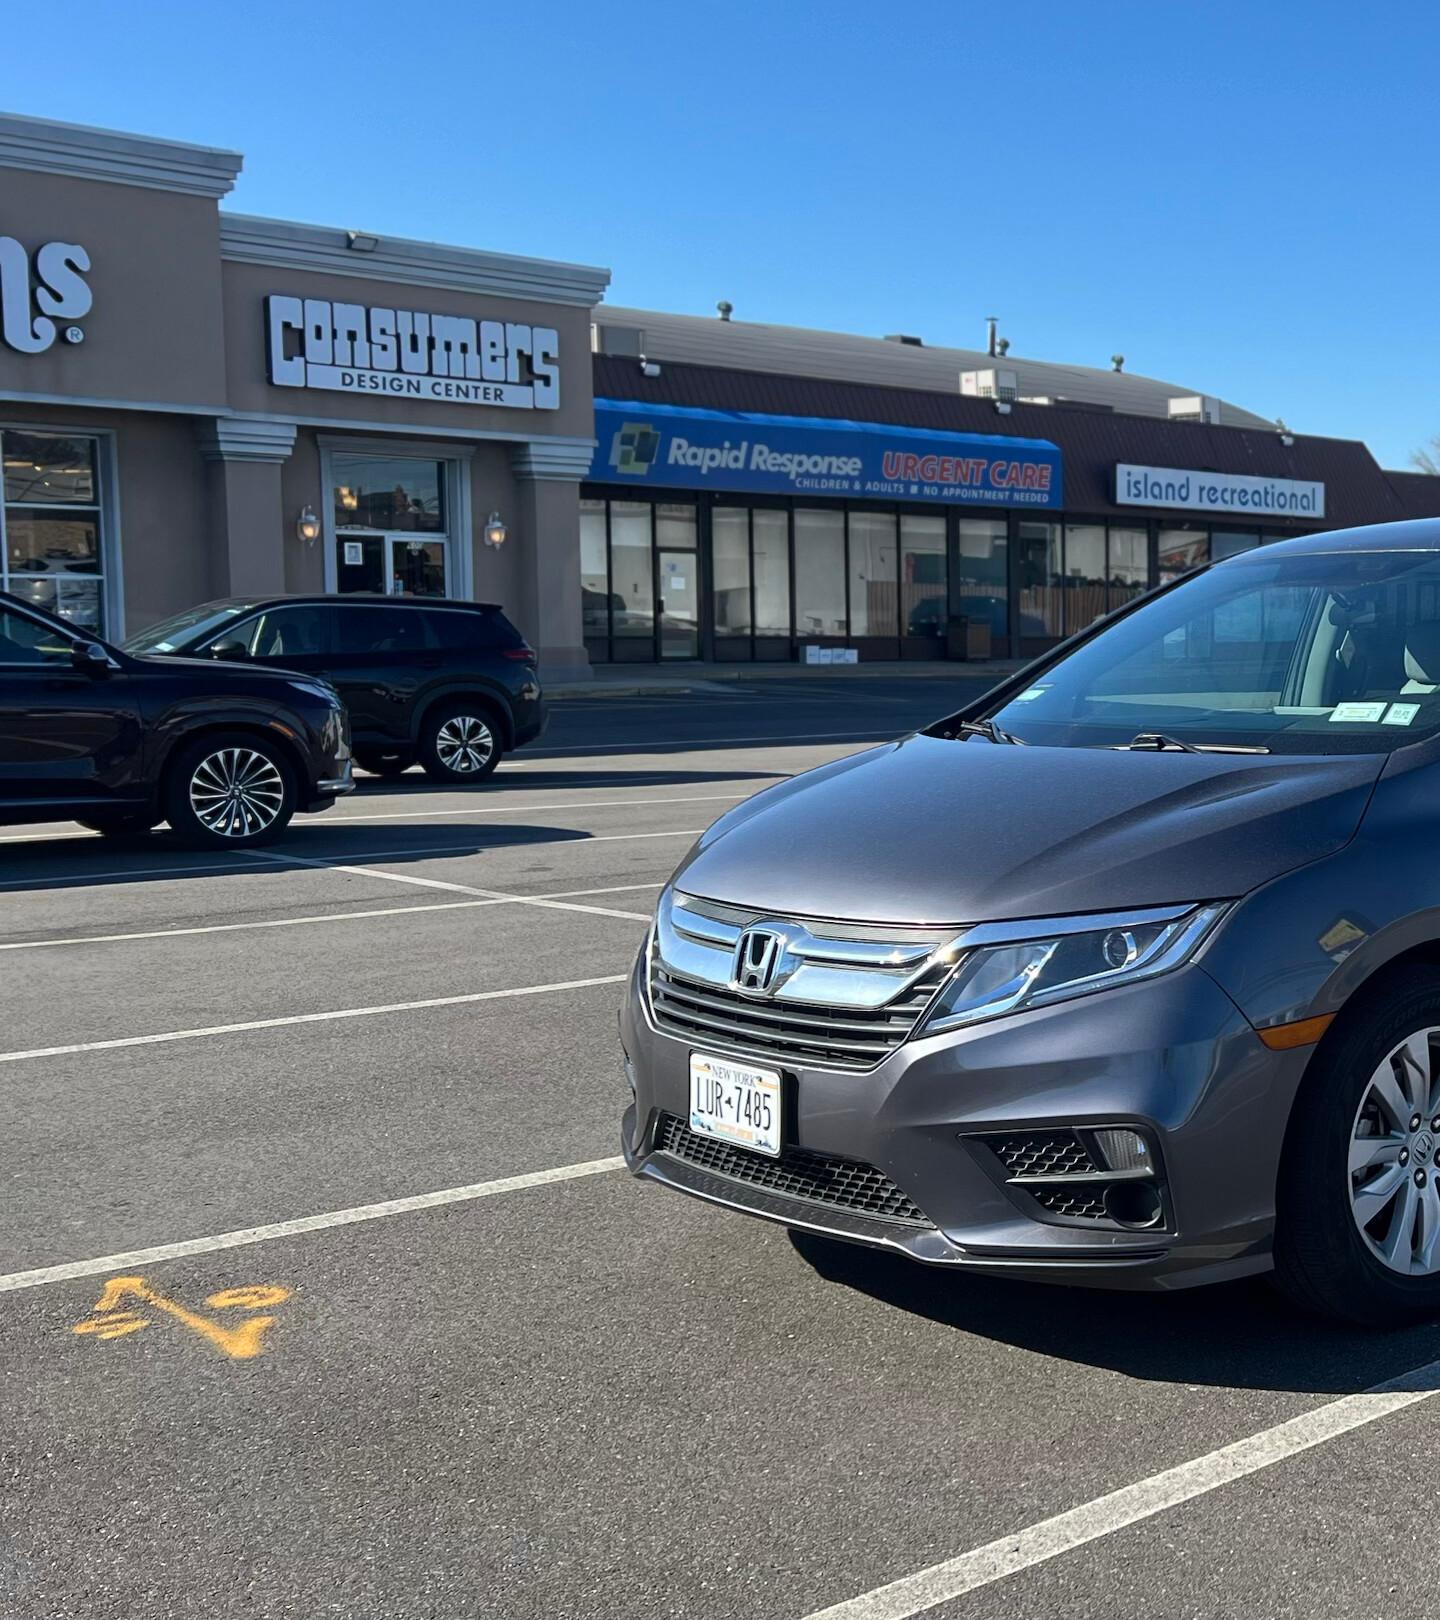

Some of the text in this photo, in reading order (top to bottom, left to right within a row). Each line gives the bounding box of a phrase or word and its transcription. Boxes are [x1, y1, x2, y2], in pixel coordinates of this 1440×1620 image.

[341, 372, 504, 402] DESIGN CENTER
[667, 437, 1052, 491] Rapid Response URGENT CARE
[795, 478, 1049, 503] CHILDREN & ADULTS NO APPOINTMENT NEEDED
[1126, 471, 1316, 512] island recreational
[712, 1065, 757, 1088] NEW YORK
